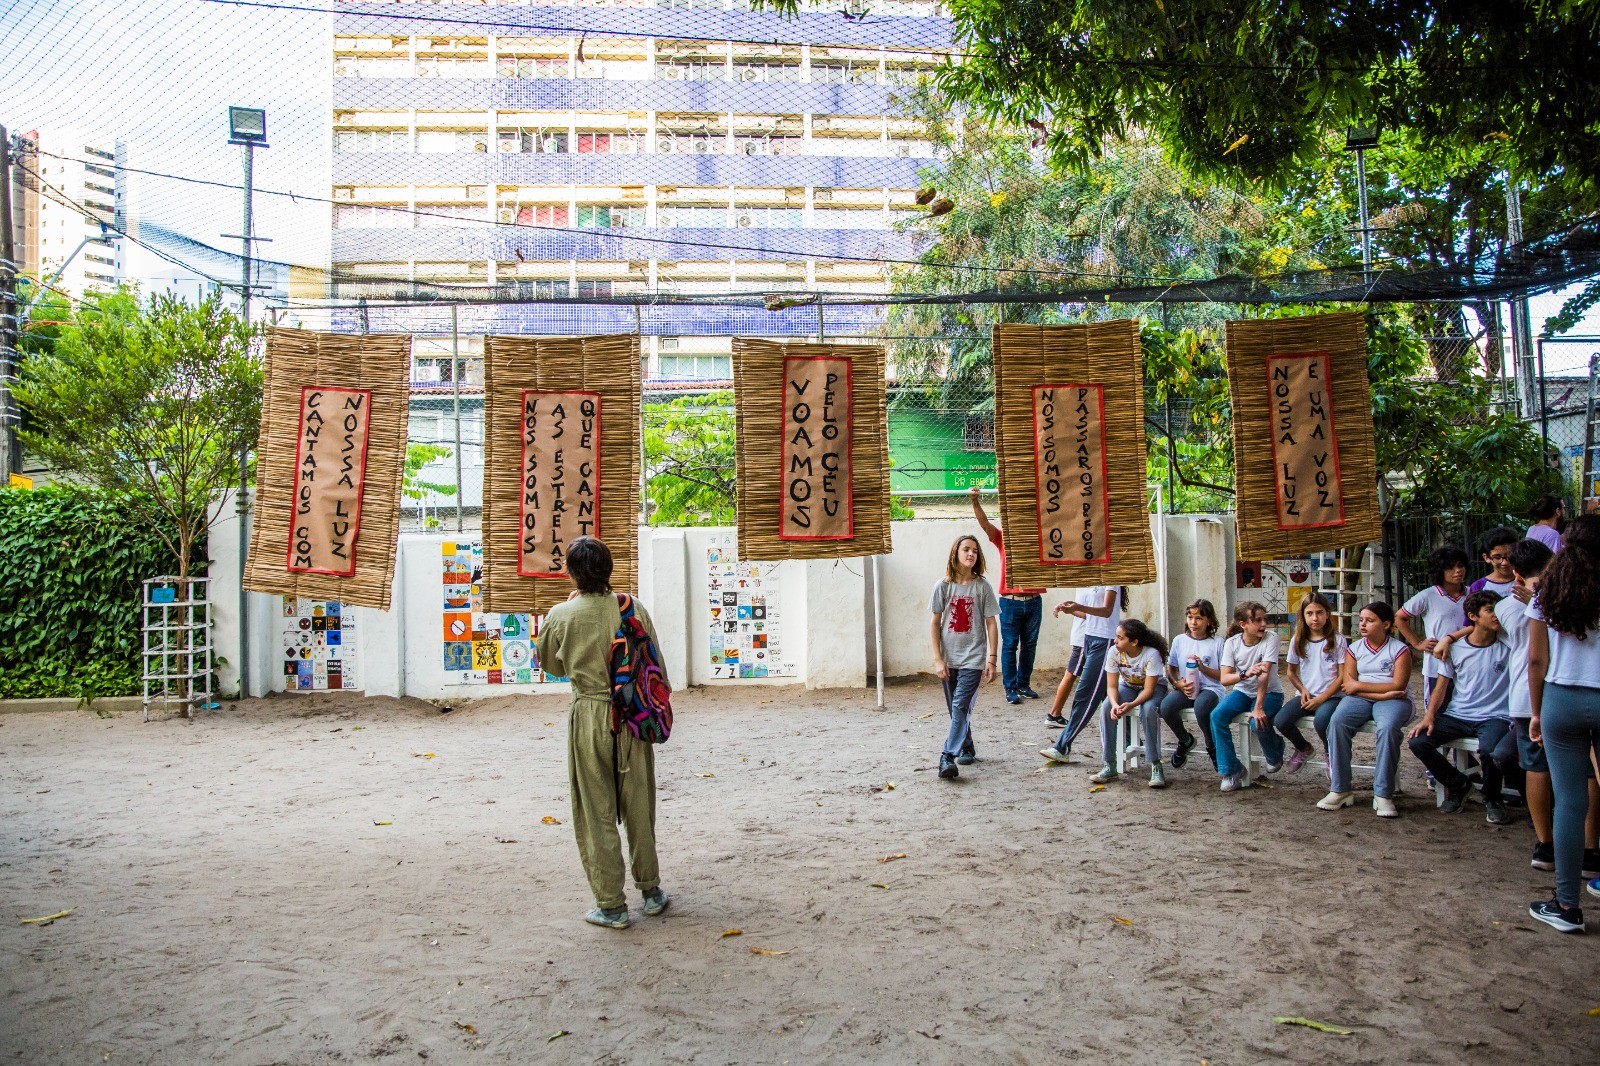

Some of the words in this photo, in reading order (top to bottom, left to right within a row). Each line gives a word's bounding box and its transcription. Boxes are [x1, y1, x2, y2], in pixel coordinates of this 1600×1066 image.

[525, 398, 540, 447] NÓS
[550, 403, 568, 441] AS
[580, 399, 597, 451] QUE
[821, 373, 839, 441] PELO
[1041, 389, 1055, 432] NÓS
[1273, 365, 1298, 446] NOSSA
[1308, 390, 1327, 440] UMA
[298, 392, 325, 515] CANTAMOS
[337, 393, 365, 490] NOSSA
[788, 378, 816, 529] VOAMOS
[1075, 388, 1094, 497] PÁSSAROS
[523, 453, 541, 555] SOMOS
[576, 461, 595, 536] CANT
[1042, 434, 1061, 515] SOMOS
[1282, 462, 1300, 517] LUZ
[1313, 450, 1334, 509] VOZ
[331, 499, 350, 561] LUZ
[548, 447, 568, 573] ESTRELAS
[294, 526, 313, 568] COM
[1047, 527, 1064, 559] OS
